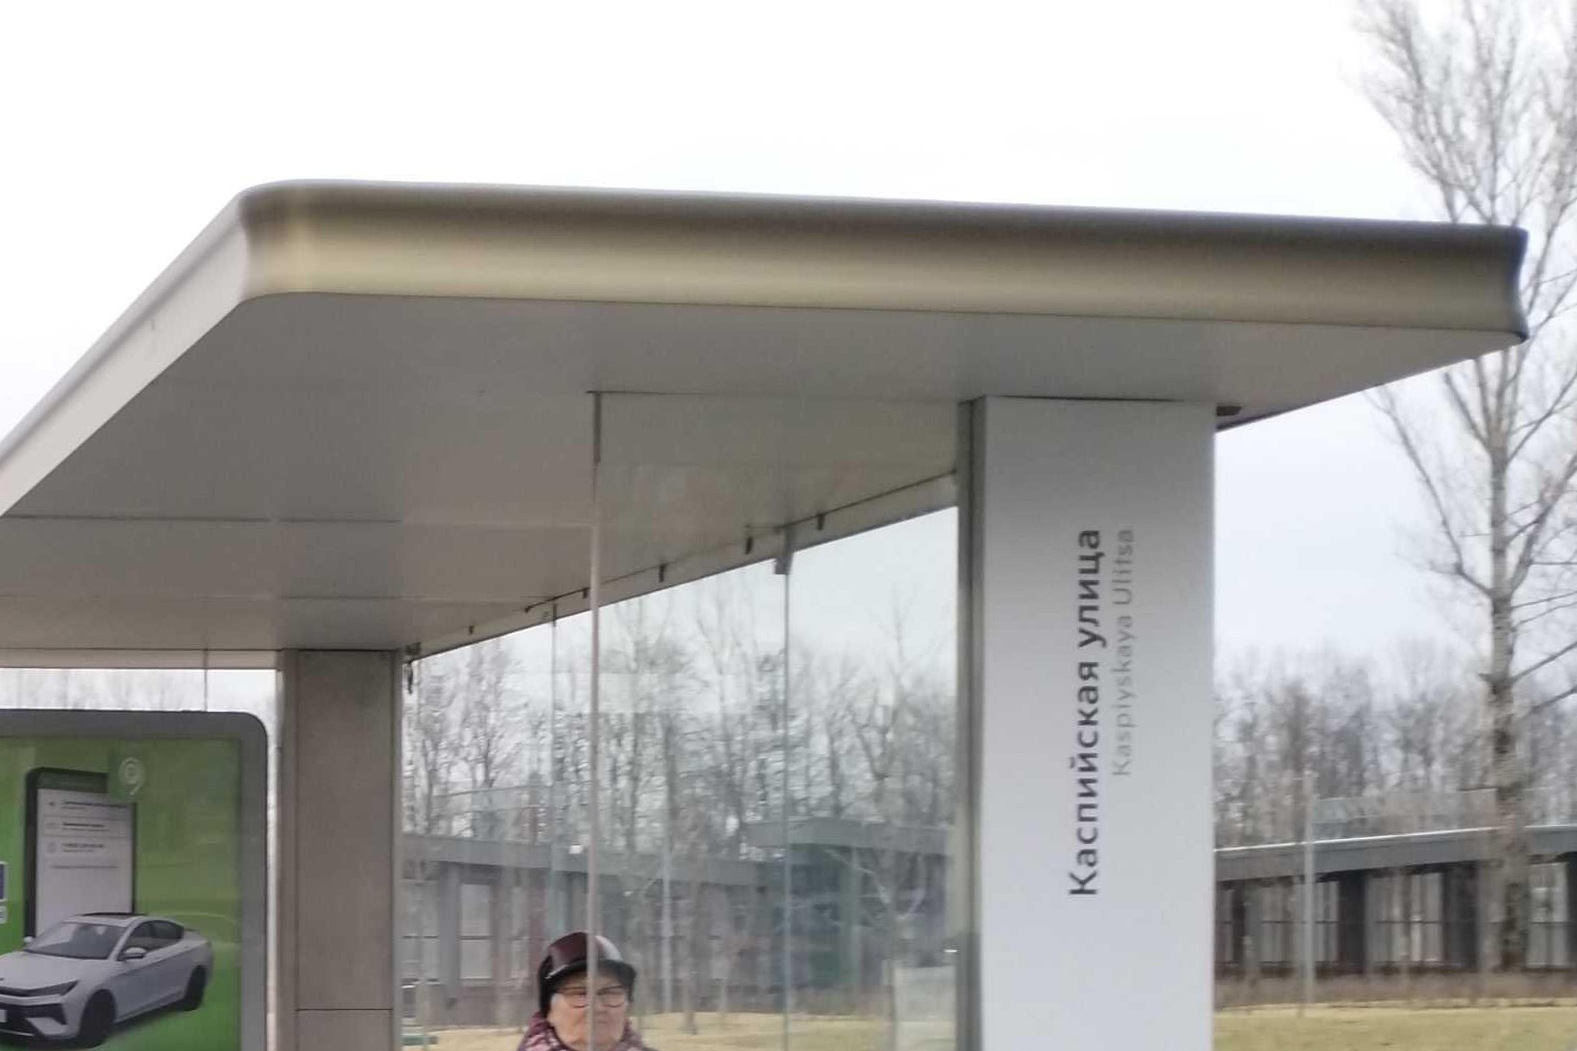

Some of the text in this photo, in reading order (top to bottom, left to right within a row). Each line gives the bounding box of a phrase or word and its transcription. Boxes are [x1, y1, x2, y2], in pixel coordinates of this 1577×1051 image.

[1069, 530, 1106, 895] Каспийская улица
[1111, 530, 1137, 776] Kaspiyskaya Ulitsa
